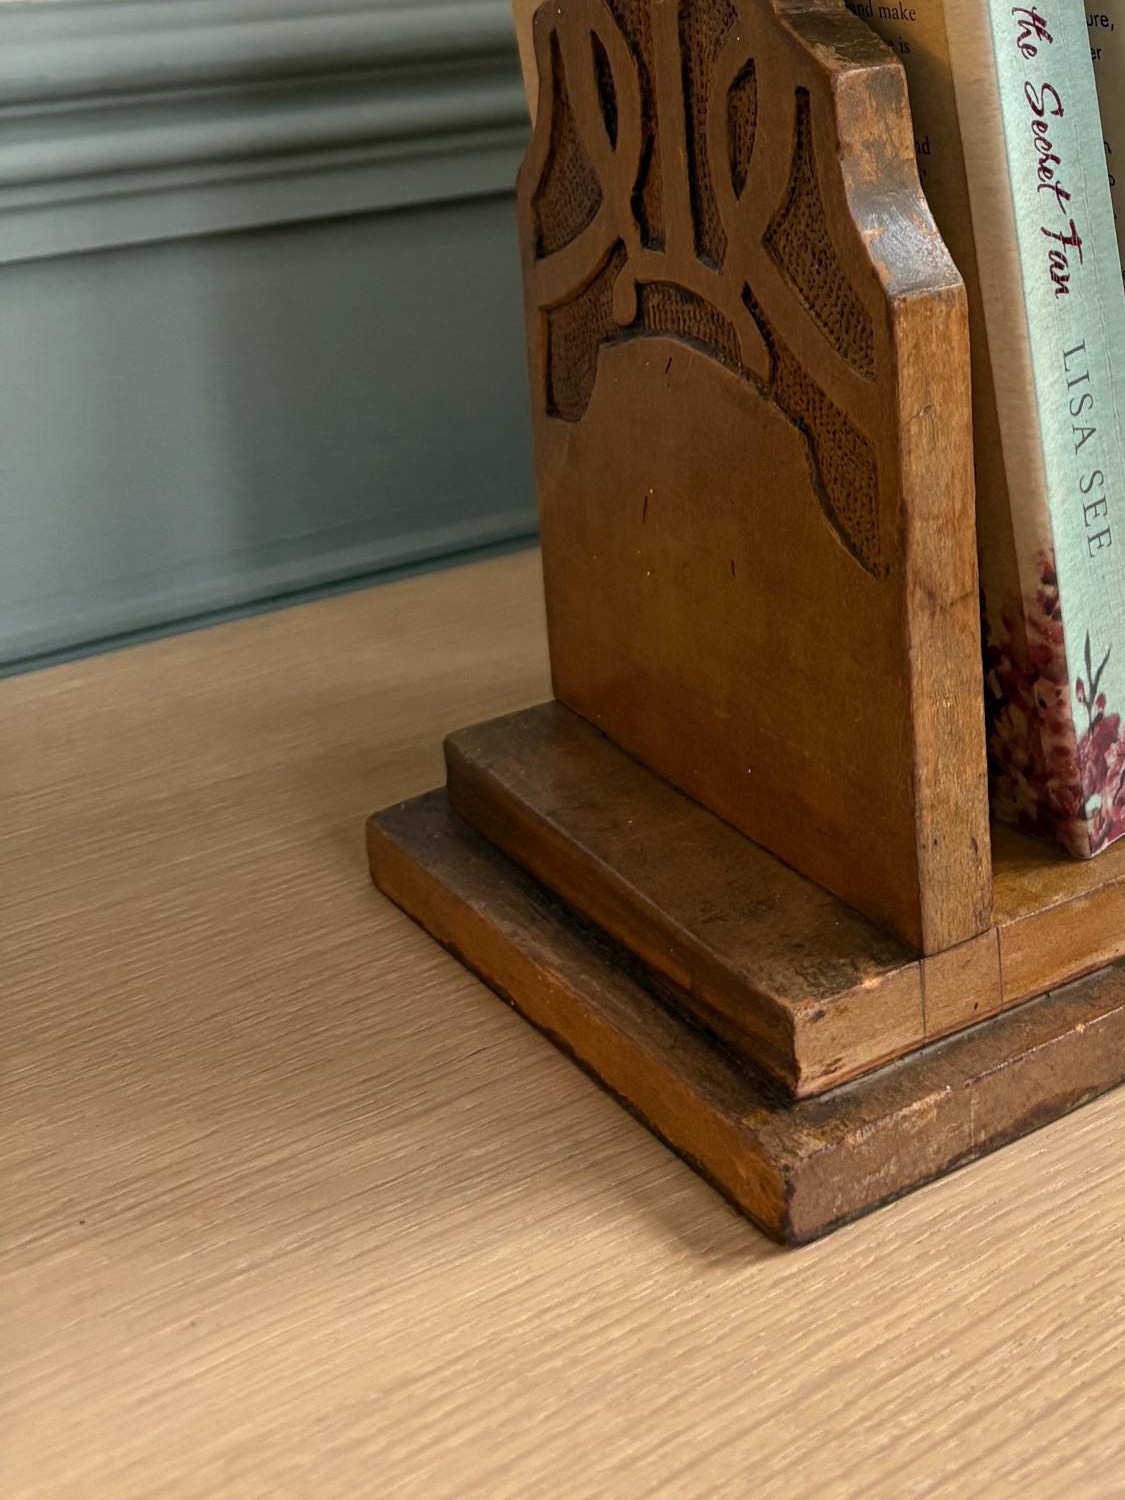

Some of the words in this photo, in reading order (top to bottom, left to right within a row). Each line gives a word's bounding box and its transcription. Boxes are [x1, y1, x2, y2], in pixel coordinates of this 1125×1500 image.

[879, 1, 917, 21] make
[900, 36, 911, 54] is
[1011, 6, 1053, 60] the
[1025, 80, 1071, 215] Secret
[1040, 218, 1083, 299] Fan
[1063, 339, 1097, 455] LISA
[1079, 469, 1113, 558] SEE
